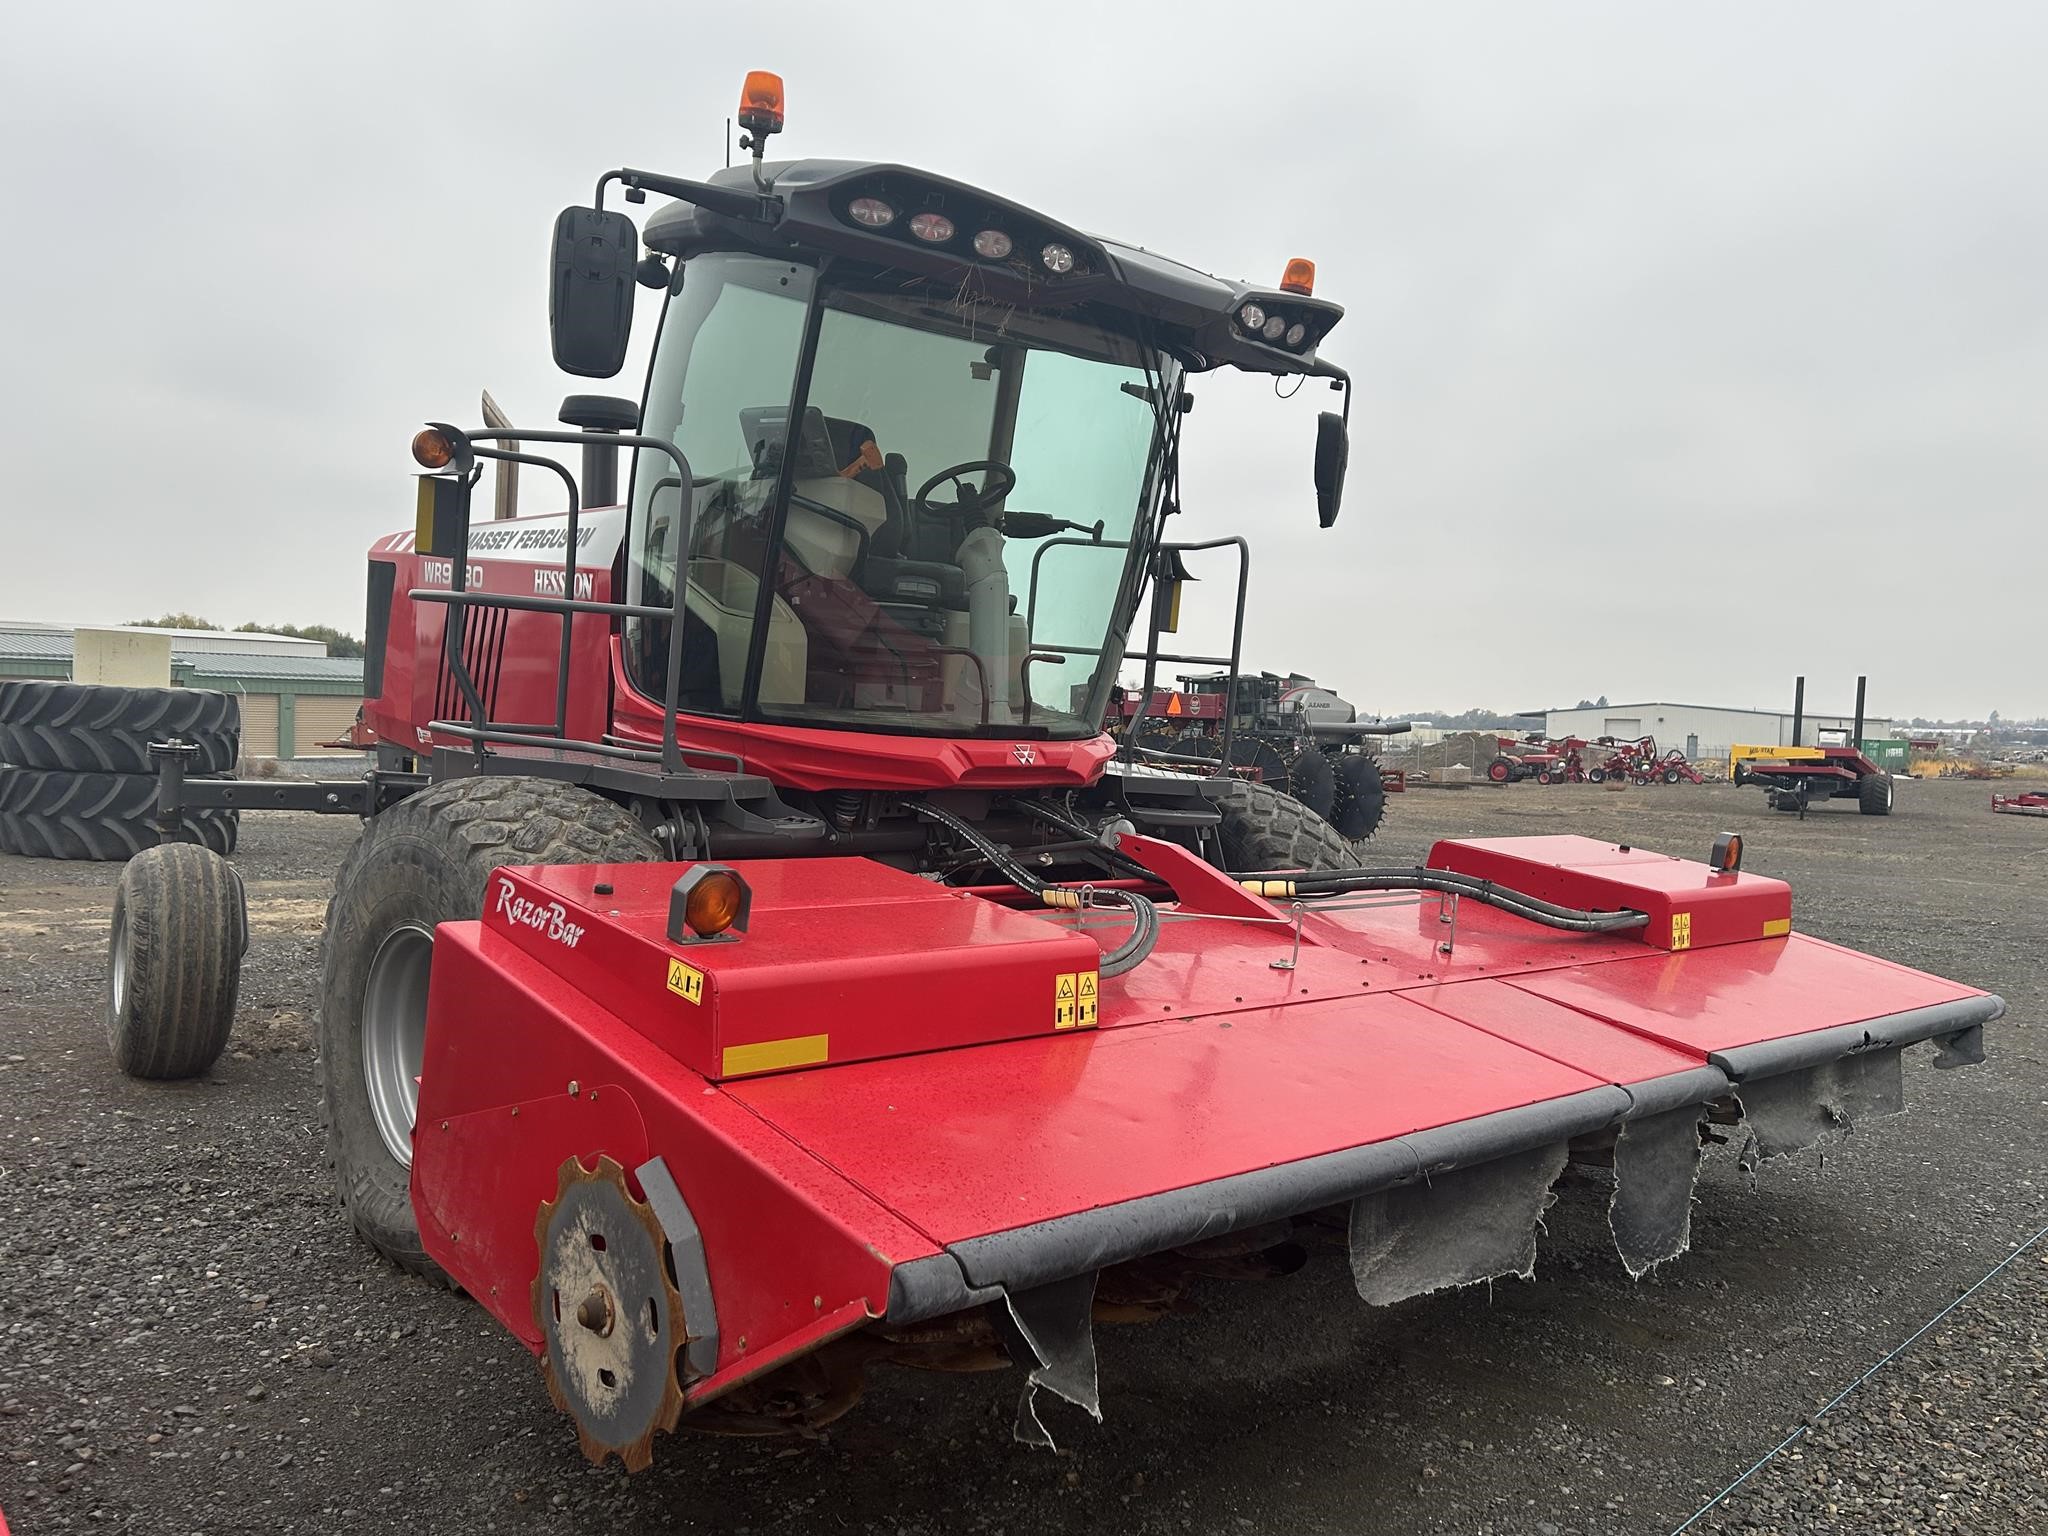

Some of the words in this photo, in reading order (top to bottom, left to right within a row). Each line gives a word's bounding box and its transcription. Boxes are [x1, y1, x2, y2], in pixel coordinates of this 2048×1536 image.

[424, 560, 484, 589] WR980
[533, 568, 594, 600] HESSON
[496, 877, 586, 948] RazorBar
